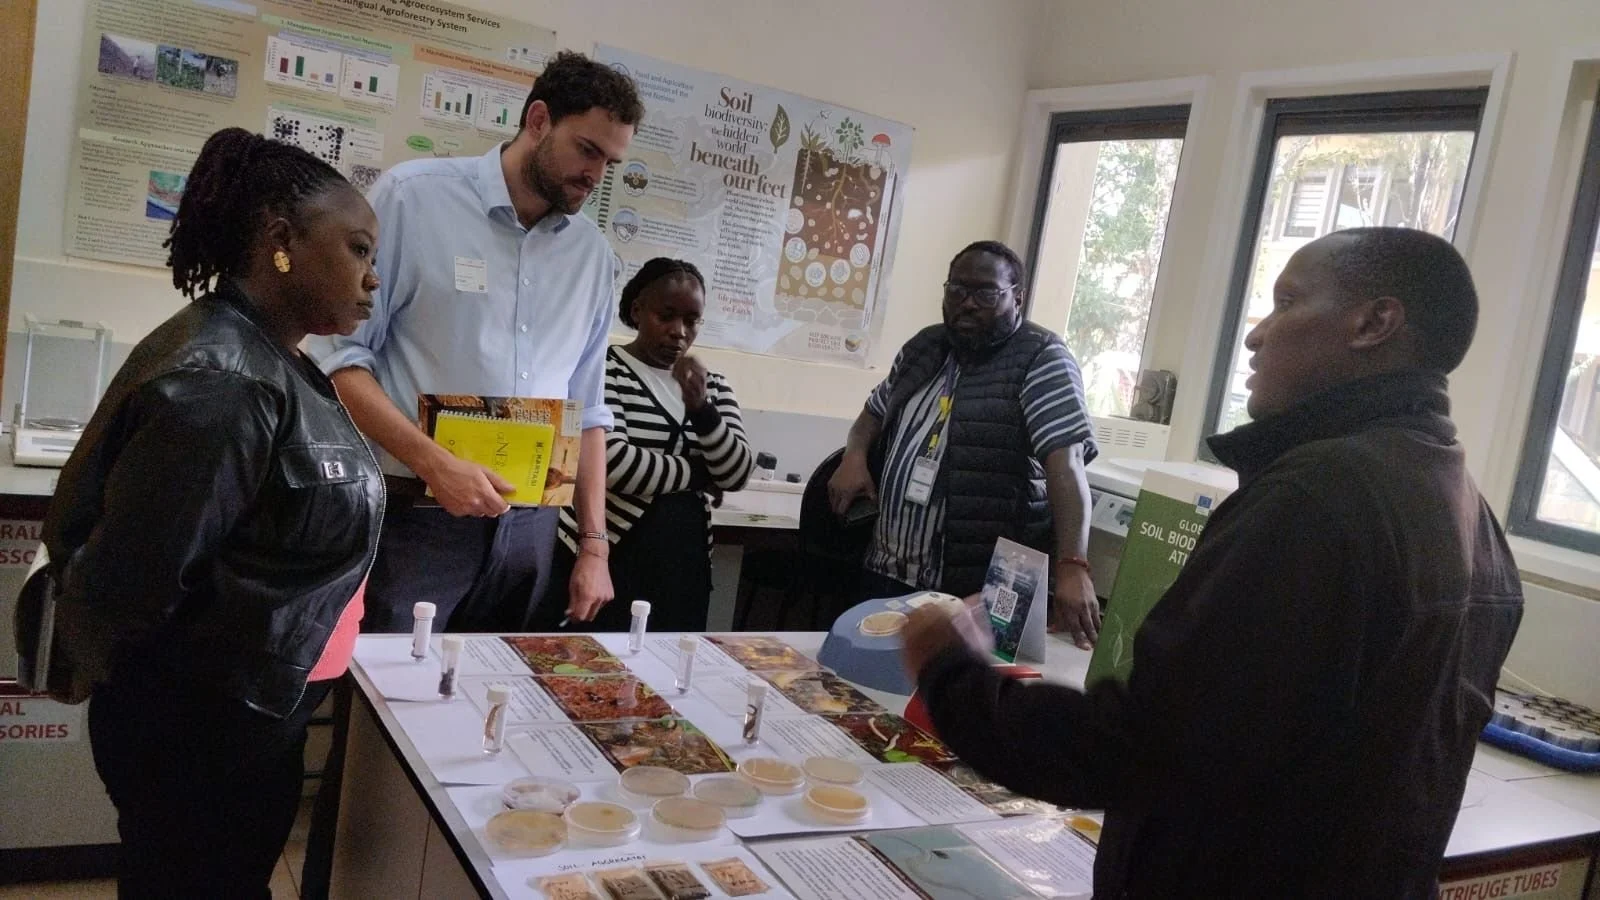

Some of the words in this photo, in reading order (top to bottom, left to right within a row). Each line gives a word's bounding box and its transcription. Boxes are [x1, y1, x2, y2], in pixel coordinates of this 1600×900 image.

[380, 5, 435, 26] Agroforestry
[437, 19, 467, 32] System
[467, 13, 501, 29] Services
[718, 86, 754, 114] Soil
[716, 139, 748, 155] world
[722, 124, 760, 145] hidden
[690, 141, 760, 176] beneath
[723, 173, 756, 192] our
[756, 174, 787, 199] feet
[1140, 521, 1165, 541] SOIL
[1514, 868, 1560, 893] TUBES
